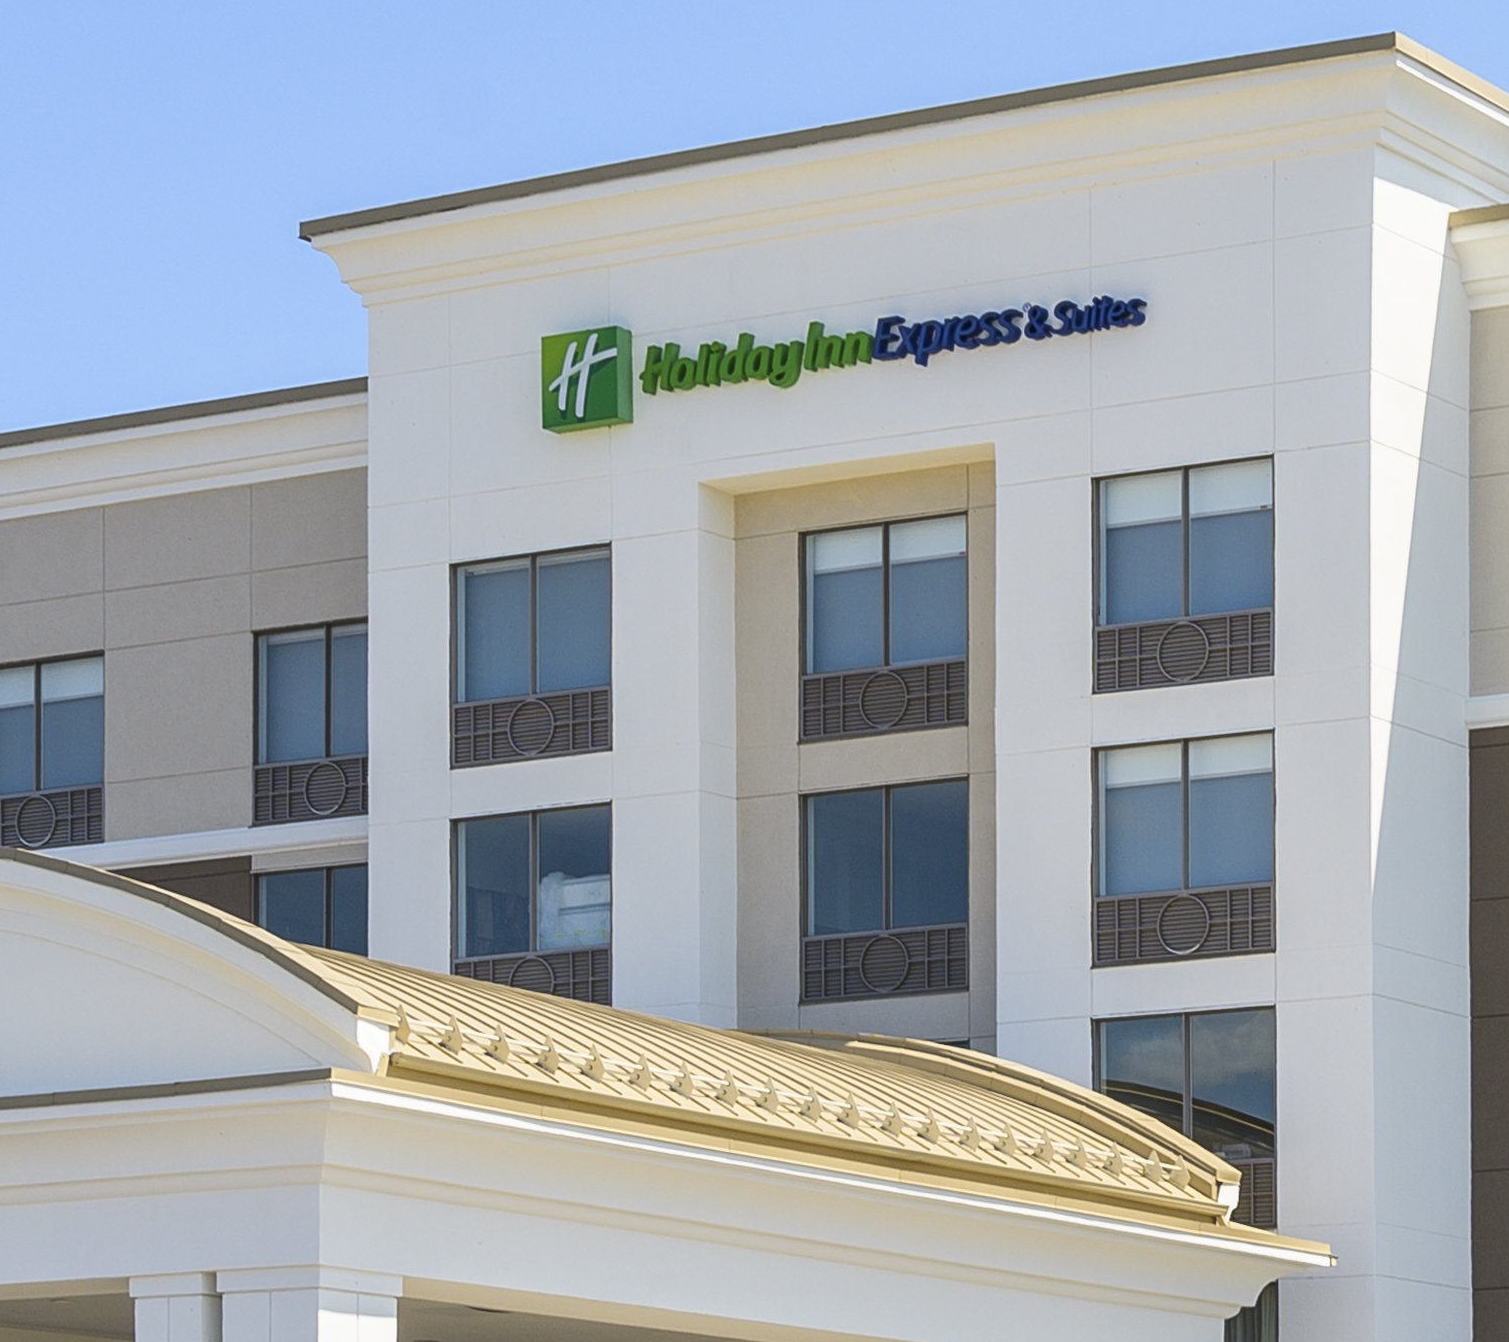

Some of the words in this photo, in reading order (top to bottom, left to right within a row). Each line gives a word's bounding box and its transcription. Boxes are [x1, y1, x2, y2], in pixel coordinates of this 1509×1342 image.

[640, 332, 805, 395] Holiday
[1024, 305, 1052, 340] &
[1051, 295, 1148, 336] Suites
